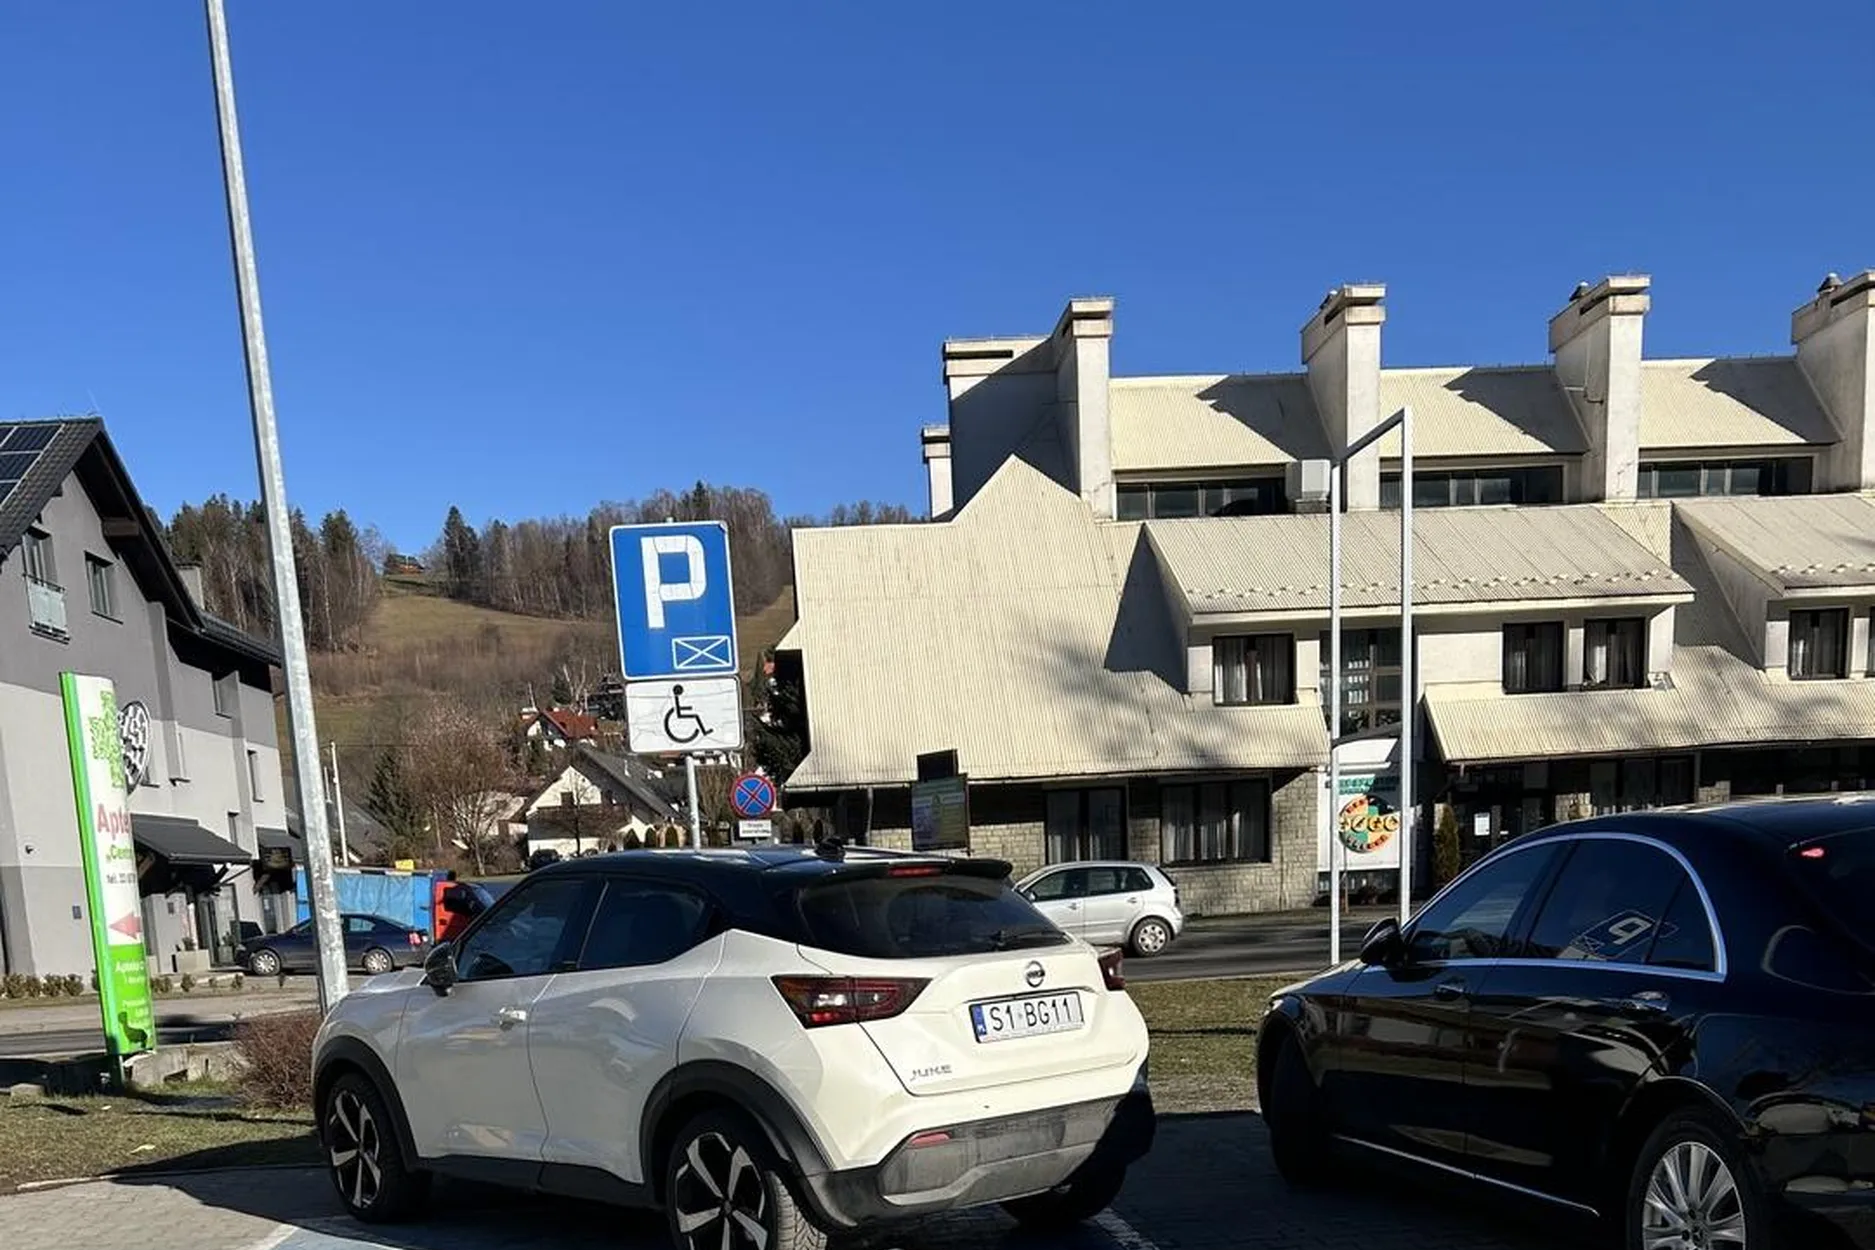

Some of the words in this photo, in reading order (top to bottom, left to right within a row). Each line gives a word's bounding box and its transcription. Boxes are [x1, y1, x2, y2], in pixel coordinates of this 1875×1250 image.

[641, 535, 706, 628] P
[990, 1004, 1015, 1032] S1
[1024, 997, 1071, 1027] BG11
